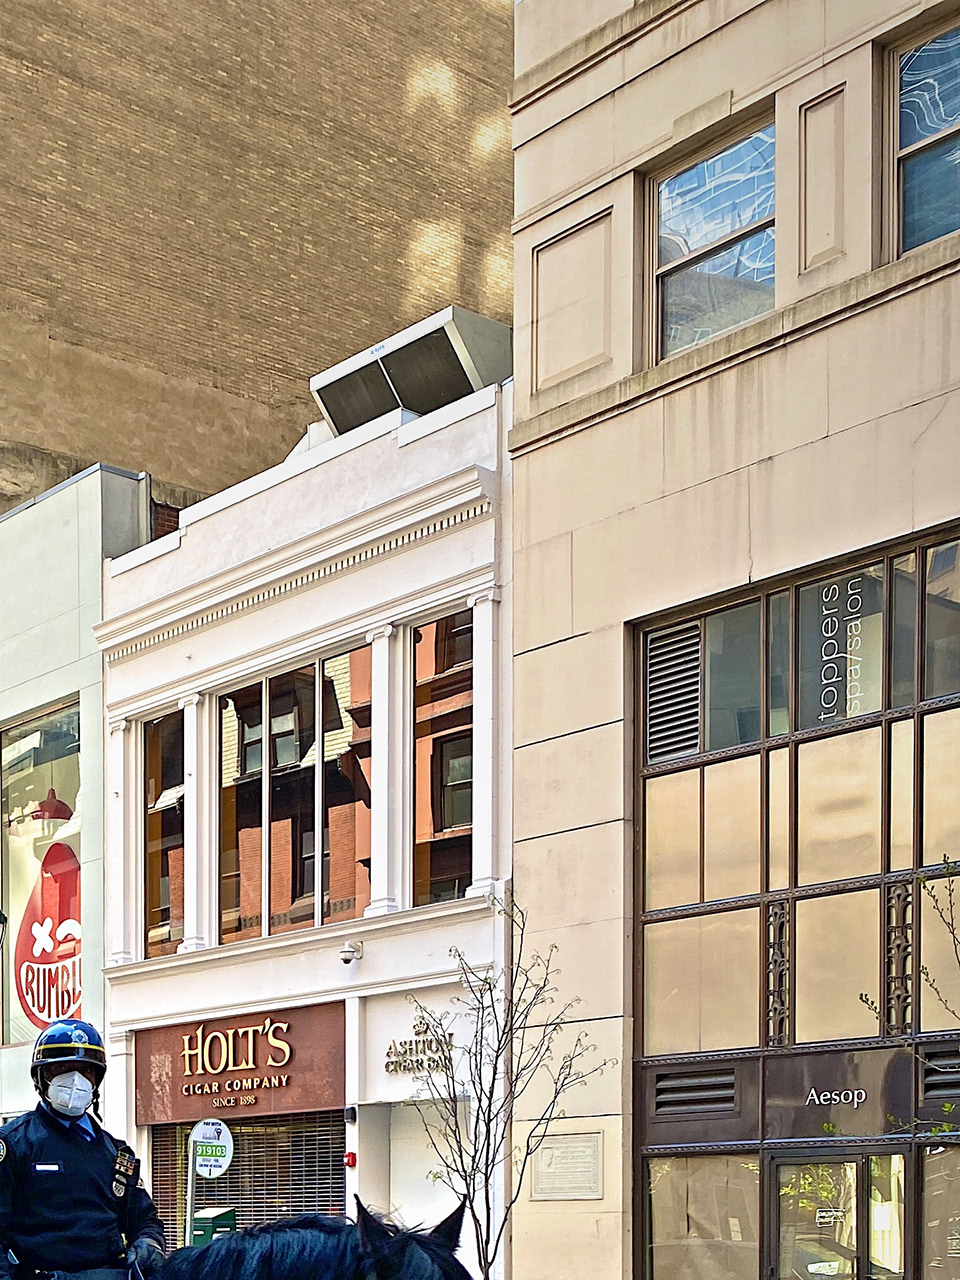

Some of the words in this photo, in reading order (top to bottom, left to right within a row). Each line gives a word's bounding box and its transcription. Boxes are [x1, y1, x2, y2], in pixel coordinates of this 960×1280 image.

[818, 584, 843, 721] toppers
[843, 577, 864, 713] spa/salon
[180, 1016, 292, 1077] HOLT'S
[182, 1081, 220, 1096] CIGAR
[224, 1075, 289, 1092] COMPANY
[212, 1096, 236, 1108] SINCE
[805, 1087, 867, 1108] Aesop
[196, 1145, 226, 1156] 919103
